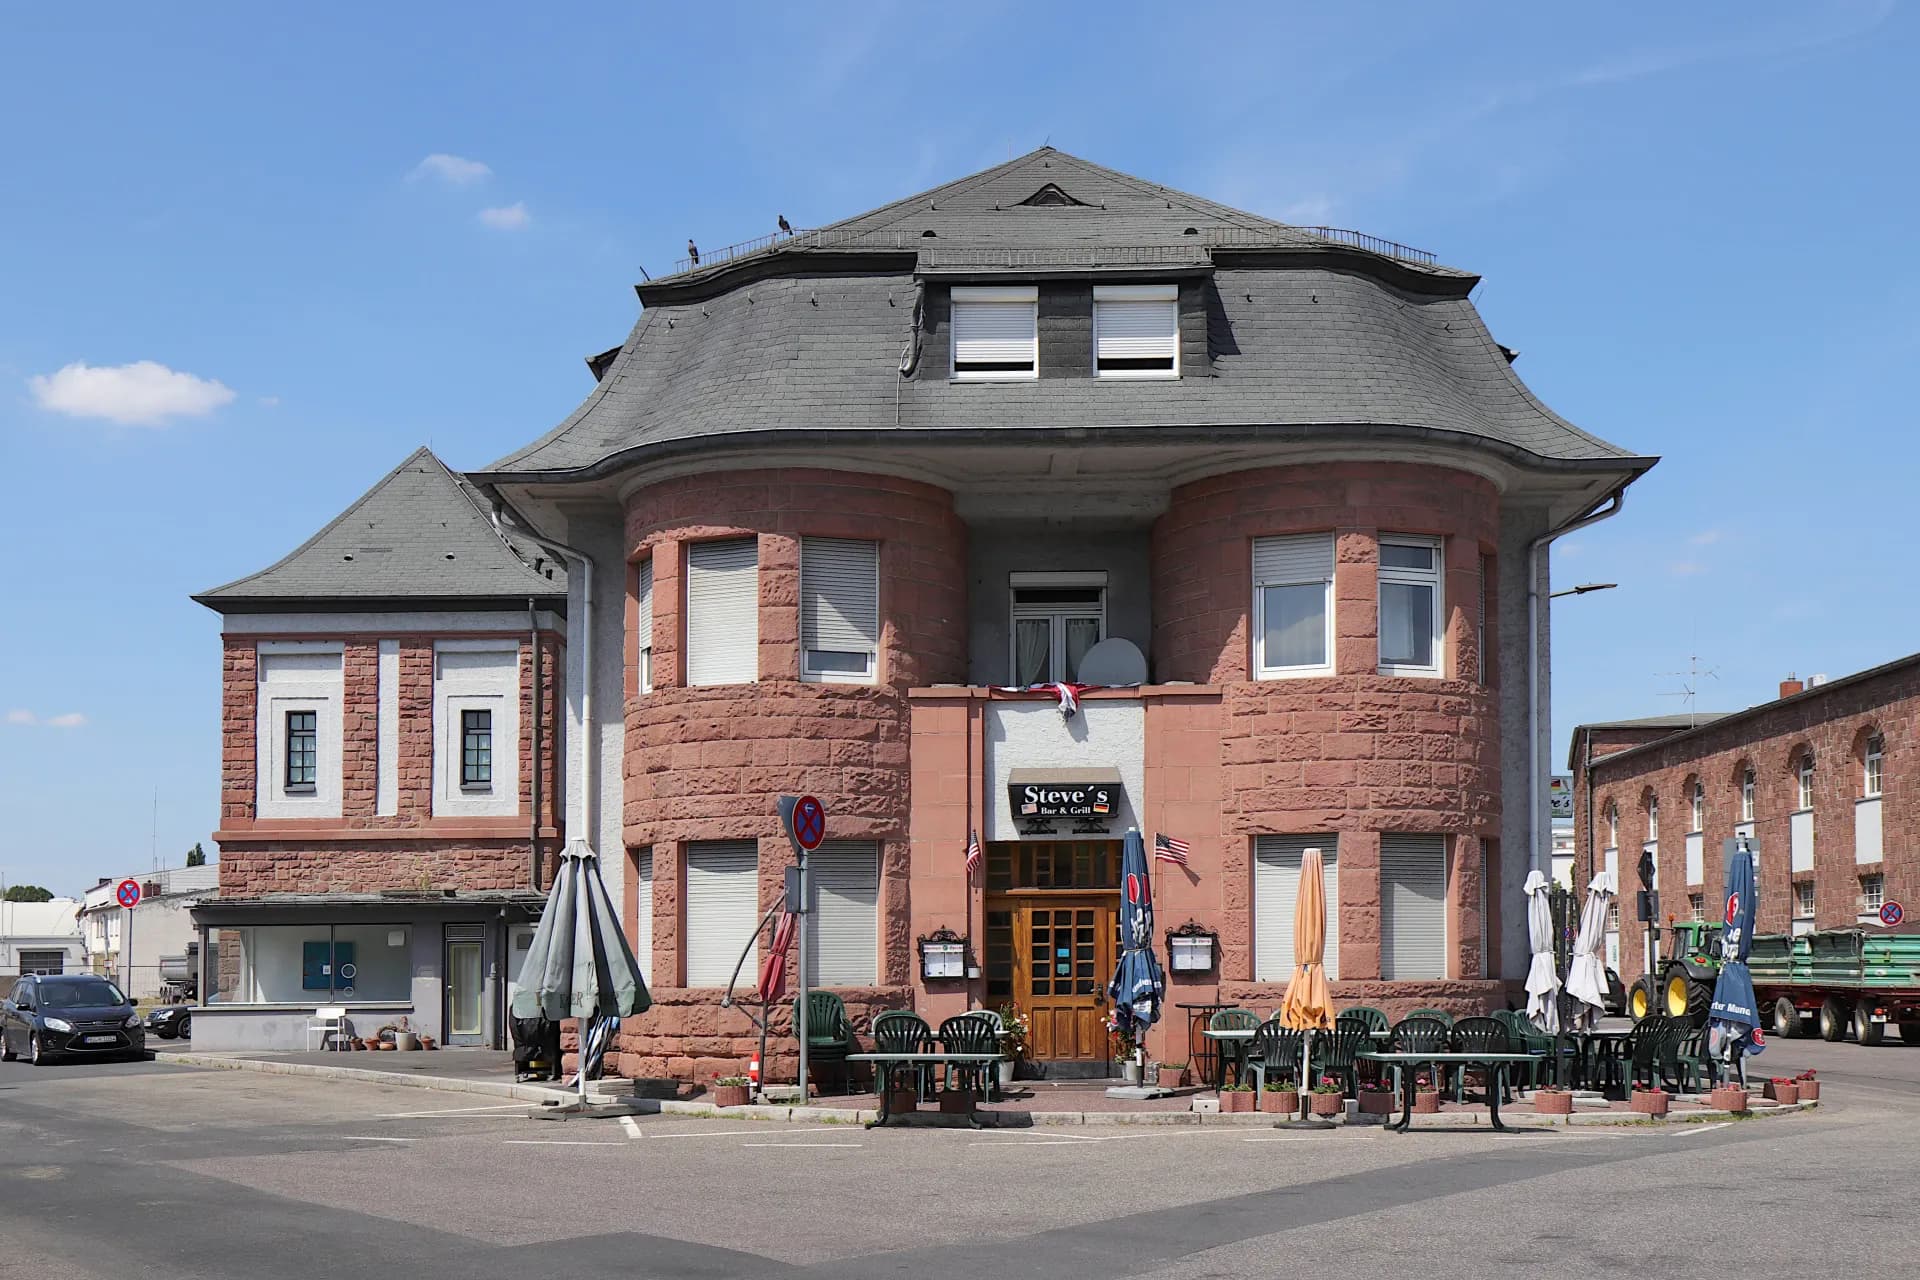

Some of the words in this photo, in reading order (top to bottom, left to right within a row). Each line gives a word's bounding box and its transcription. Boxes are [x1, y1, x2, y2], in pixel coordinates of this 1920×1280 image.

[1041, 807, 1057, 815] Bar
[1059, 807, 1068, 815] &
[1070, 806, 1091, 815] Grill
